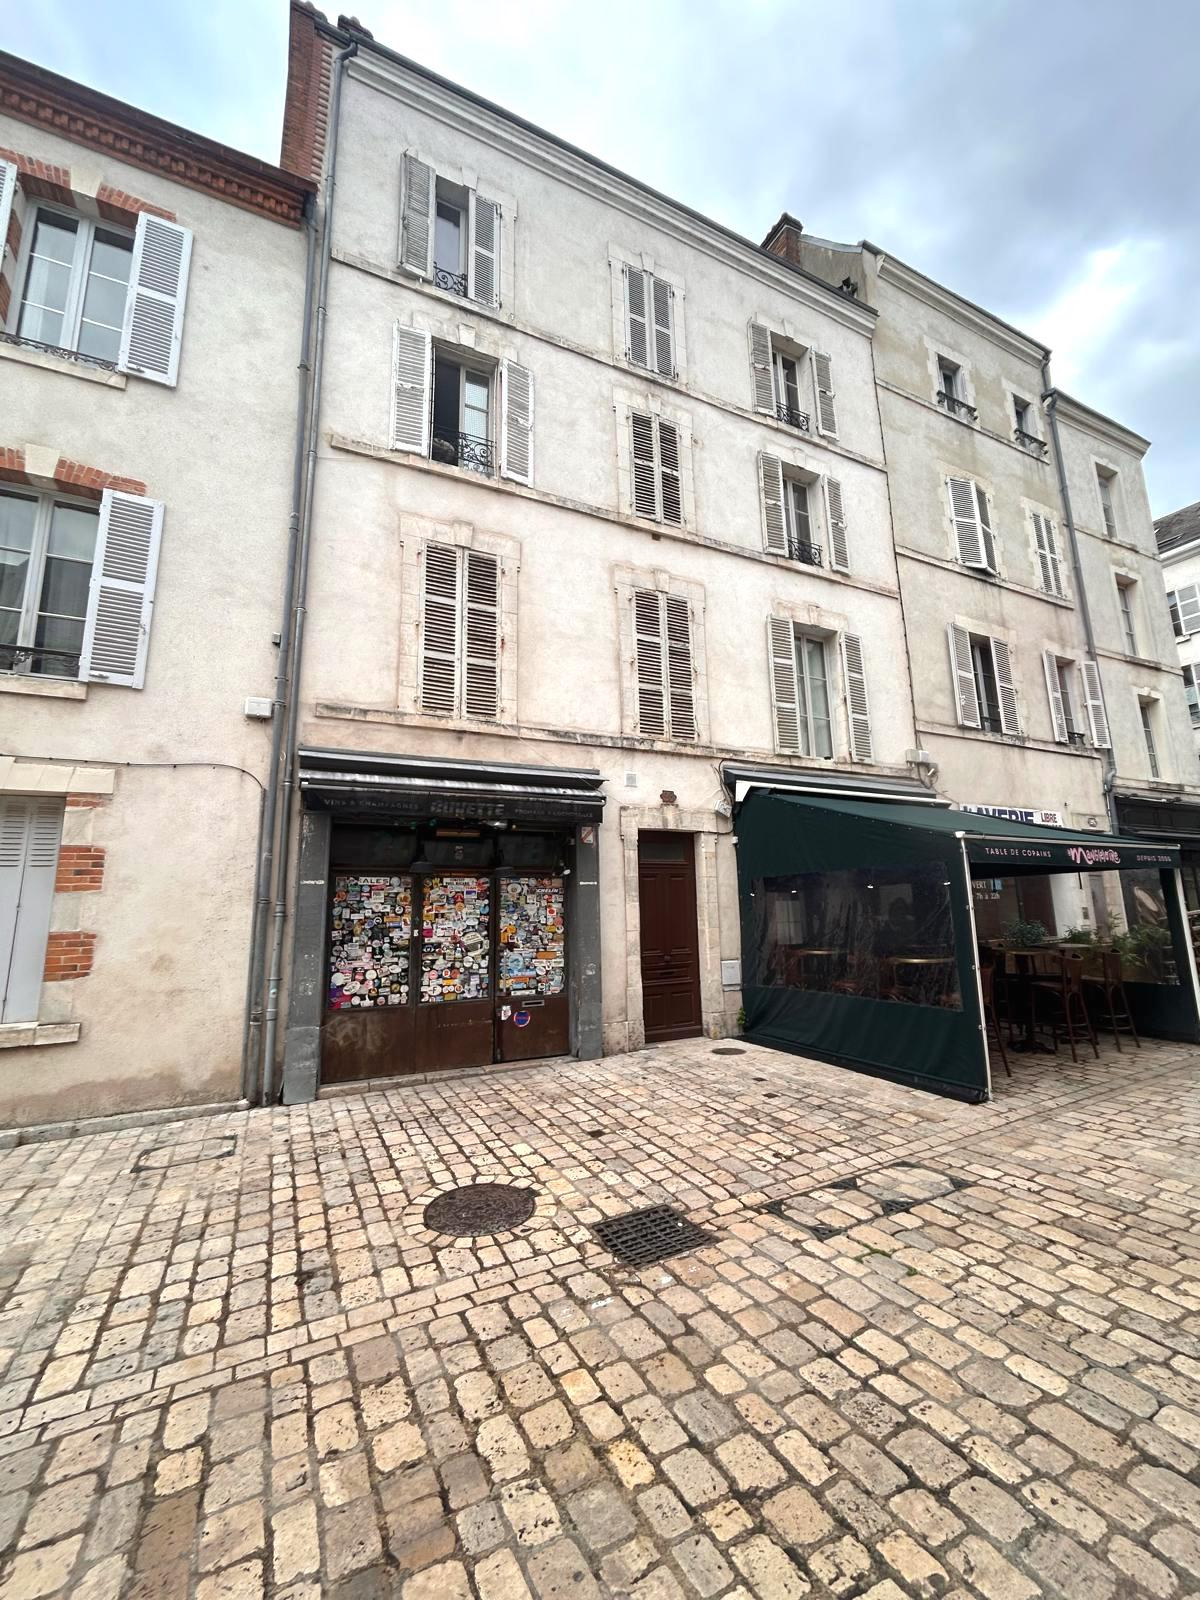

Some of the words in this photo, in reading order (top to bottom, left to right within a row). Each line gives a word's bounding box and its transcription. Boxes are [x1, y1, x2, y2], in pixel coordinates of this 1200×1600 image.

[1041, 812, 1058, 823] LIBRE
[985, 847, 1008, 856] TABLE
[1010, 848, 1019, 856] DE
[1022, 849, 1052, 858] COPAINS
